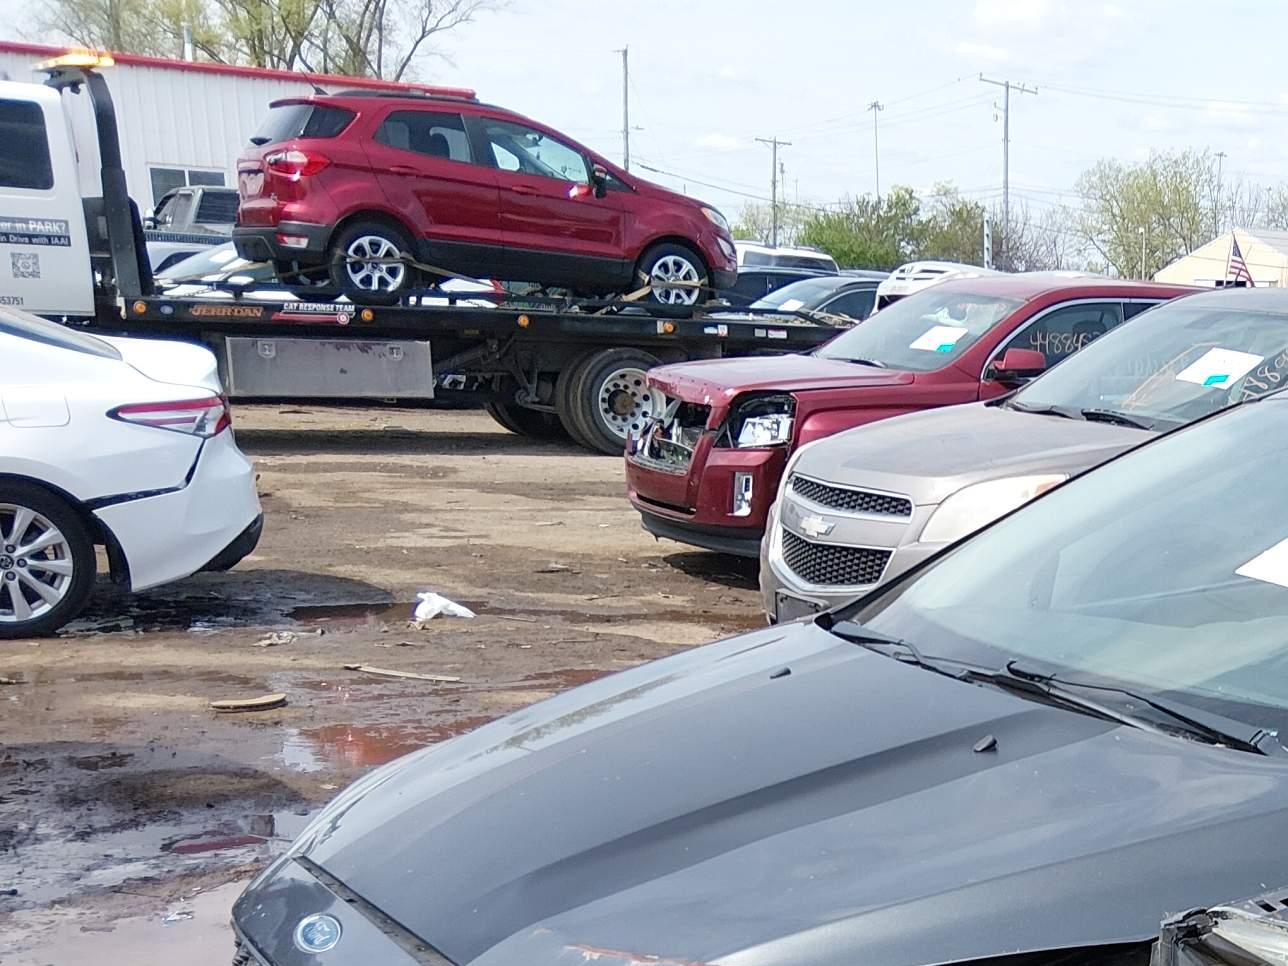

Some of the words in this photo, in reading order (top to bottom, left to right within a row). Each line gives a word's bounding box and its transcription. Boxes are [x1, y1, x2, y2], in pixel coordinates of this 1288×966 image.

[29, 220, 66, 234] PARK?
[9, 234, 29, 244] Drive
[31, 236, 49, 245] with
[283, 302, 298, 310] CAT
[299, 303, 334, 311] RESPONSE
[335, 304, 355, 312] TEAM
